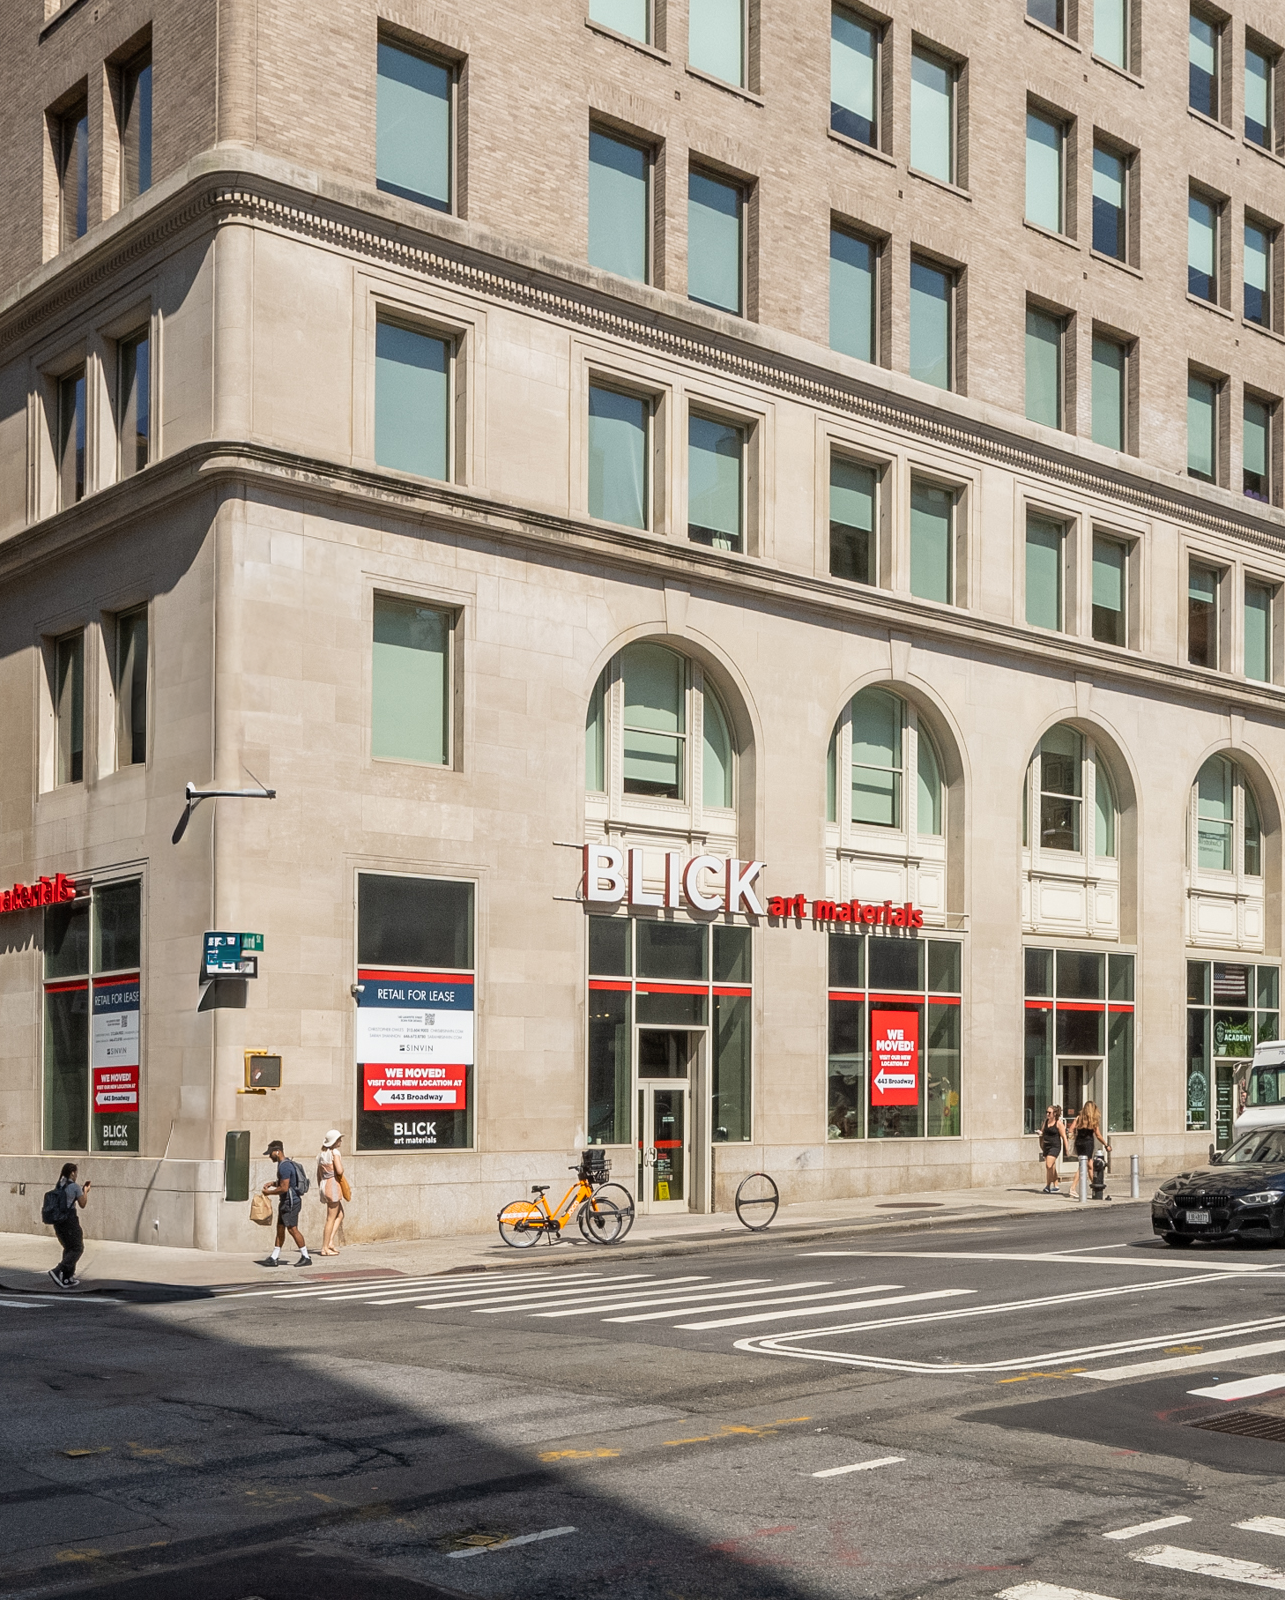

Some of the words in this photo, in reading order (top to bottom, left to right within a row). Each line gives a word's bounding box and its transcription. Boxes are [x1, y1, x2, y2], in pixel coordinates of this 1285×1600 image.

[583, 844, 766, 915] BLICK
[768, 894, 806, 918] art
[816, 899, 924, 928] materials
[95, 994, 110, 1006] RETAIL
[112, 993, 122, 1004] FOR
[124, 991, 139, 1003] LEASE
[378, 989, 405, 1000] RETAIL
[408, 990, 426, 1000] FOR
[429, 991, 455, 1002] LEASE
[887, 1029, 904, 1040] WE
[1224, 1034, 1251, 1042] ACADEMY
[876, 1040, 914, 1051] MOVED!
[101, 1074, 110, 1083] WE
[111, 1073, 132, 1082] MOVED!
[385, 1068, 403, 1077] WE
[405, 1068, 445, 1078] MOVED!
[112, 1094, 130, 1102] Broadway
[103, 1125, 128, 1137] BLICK
[394, 1122, 436, 1135] BLICK
[567, 1200, 579, 1217] JOCO
